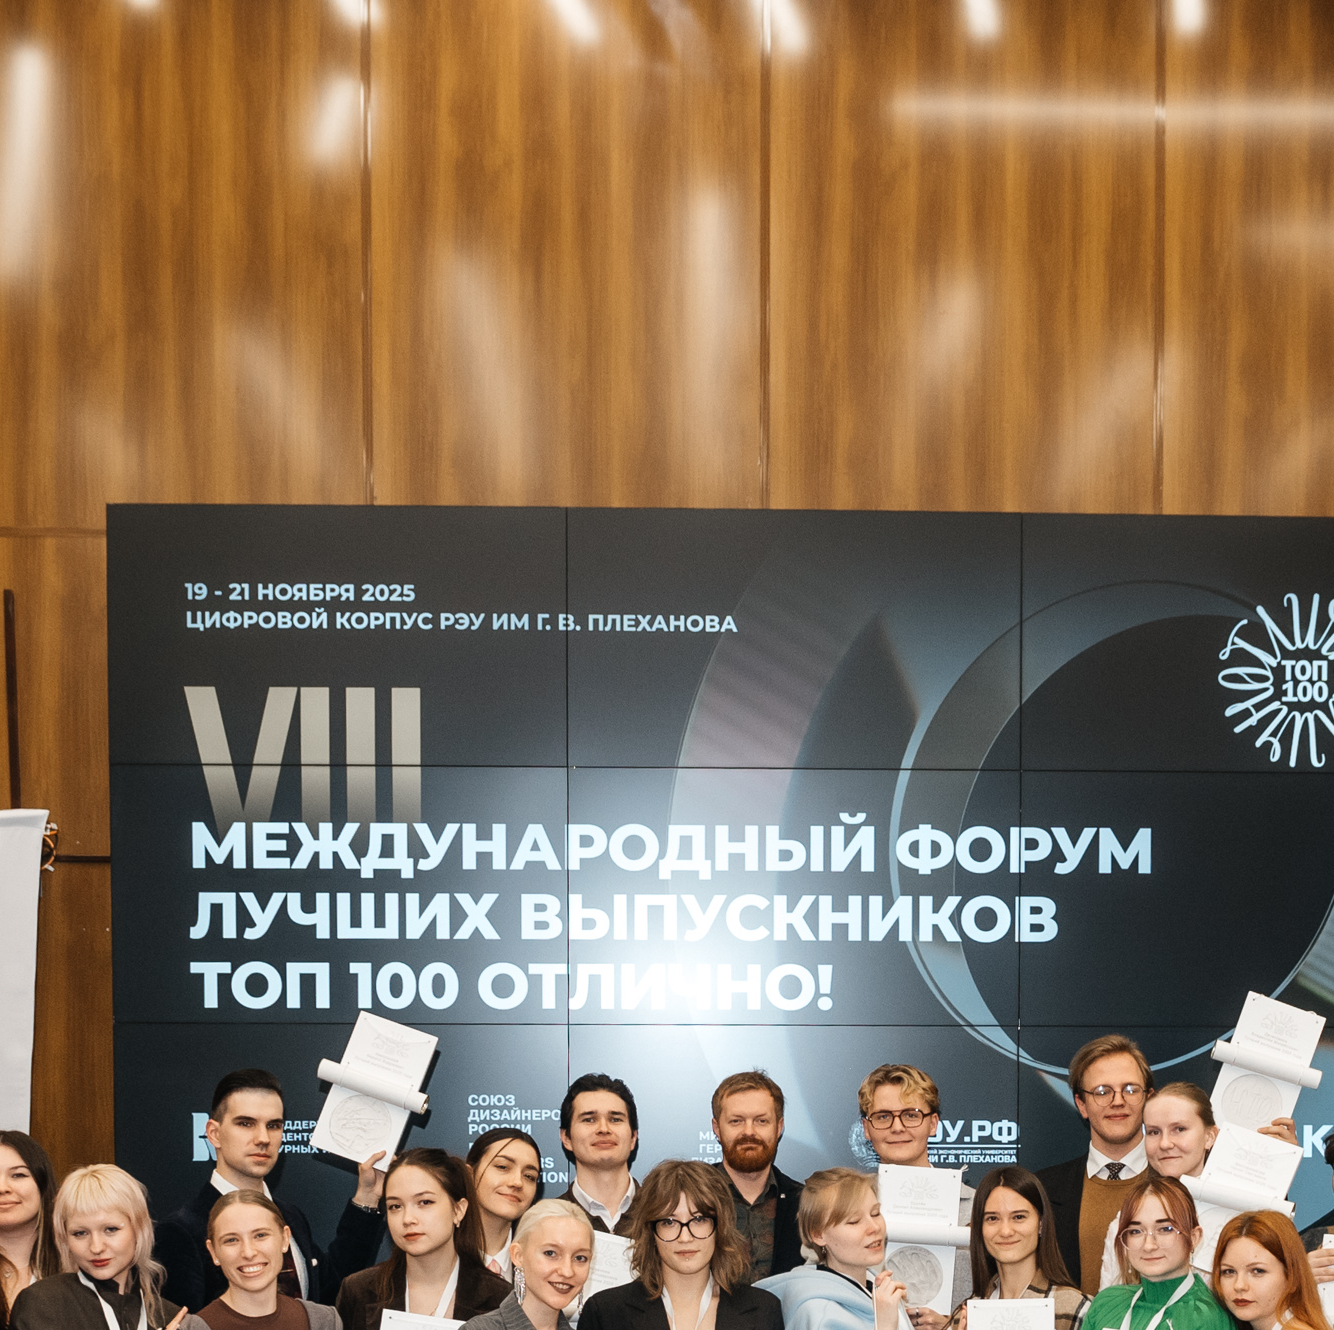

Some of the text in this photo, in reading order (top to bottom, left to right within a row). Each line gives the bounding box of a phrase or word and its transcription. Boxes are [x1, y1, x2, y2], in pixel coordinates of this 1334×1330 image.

[185, 583, 208, 601] 19
[228, 583, 250, 601] 21
[257, 583, 355, 602] НОЯБРЯ
[361, 584, 416, 602] 2025
[186, 607, 739, 633] ЦИФРОВОЙ КОРПУС РЭУ ИМ Г. В. ПЛЕХАНОВА
[1281, 660, 1328, 681] ТОП
[1281, 681, 1329, 702] 100
[184, 686, 421, 824] VIII
[190, 812, 1152, 880] МЕЖДУНАРОДНЫЙ ФОРУМ
[190, 891, 1059, 944] ЛУЧШИХ ВЫПУСКНИКОВ
[190, 961, 834, 1012] ТОП 100 ОТЛИЧНО!
[468, 1094, 516, 1106] СОЮЗ
[468, 1107, 560, 1122] ДИЗАЙНЕРО
[959, 1155, 1017, 1163] ПЛЕХАНОВА
